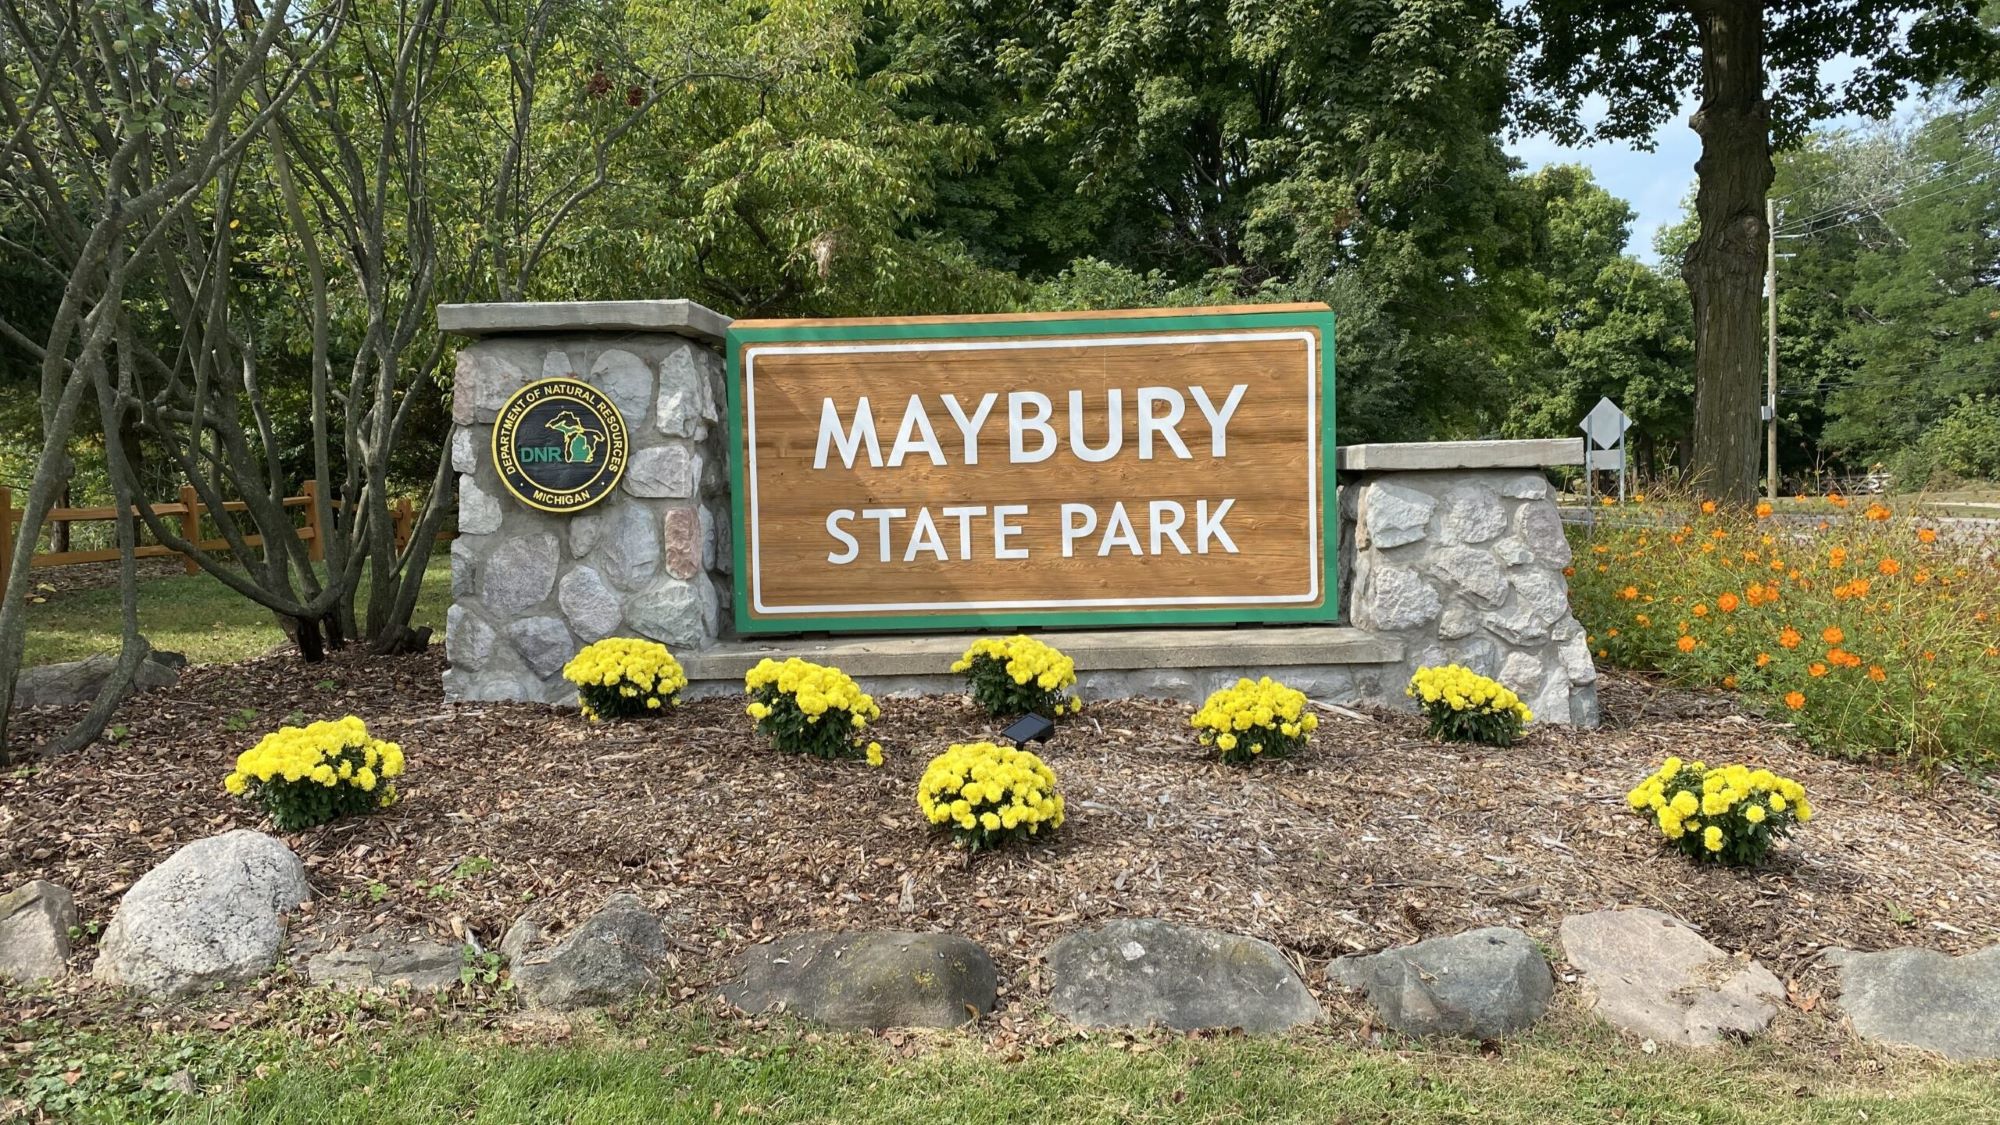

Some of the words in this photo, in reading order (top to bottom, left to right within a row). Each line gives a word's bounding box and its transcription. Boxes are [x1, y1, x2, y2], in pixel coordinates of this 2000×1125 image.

[500, 399, 527, 475] DEPARTMENT
[526, 389, 541, 402] OF
[544, 384, 595, 405] NATURAL
[597, 401, 623, 473] RESOURCES
[520, 446, 562, 463] DNR
[812, 383, 1249, 470] MAYBURY
[533, 489, 591, 505] MICHIGAN
[825, 504, 1029, 565] STATE
[1060, 498, 1240, 558] PARK
